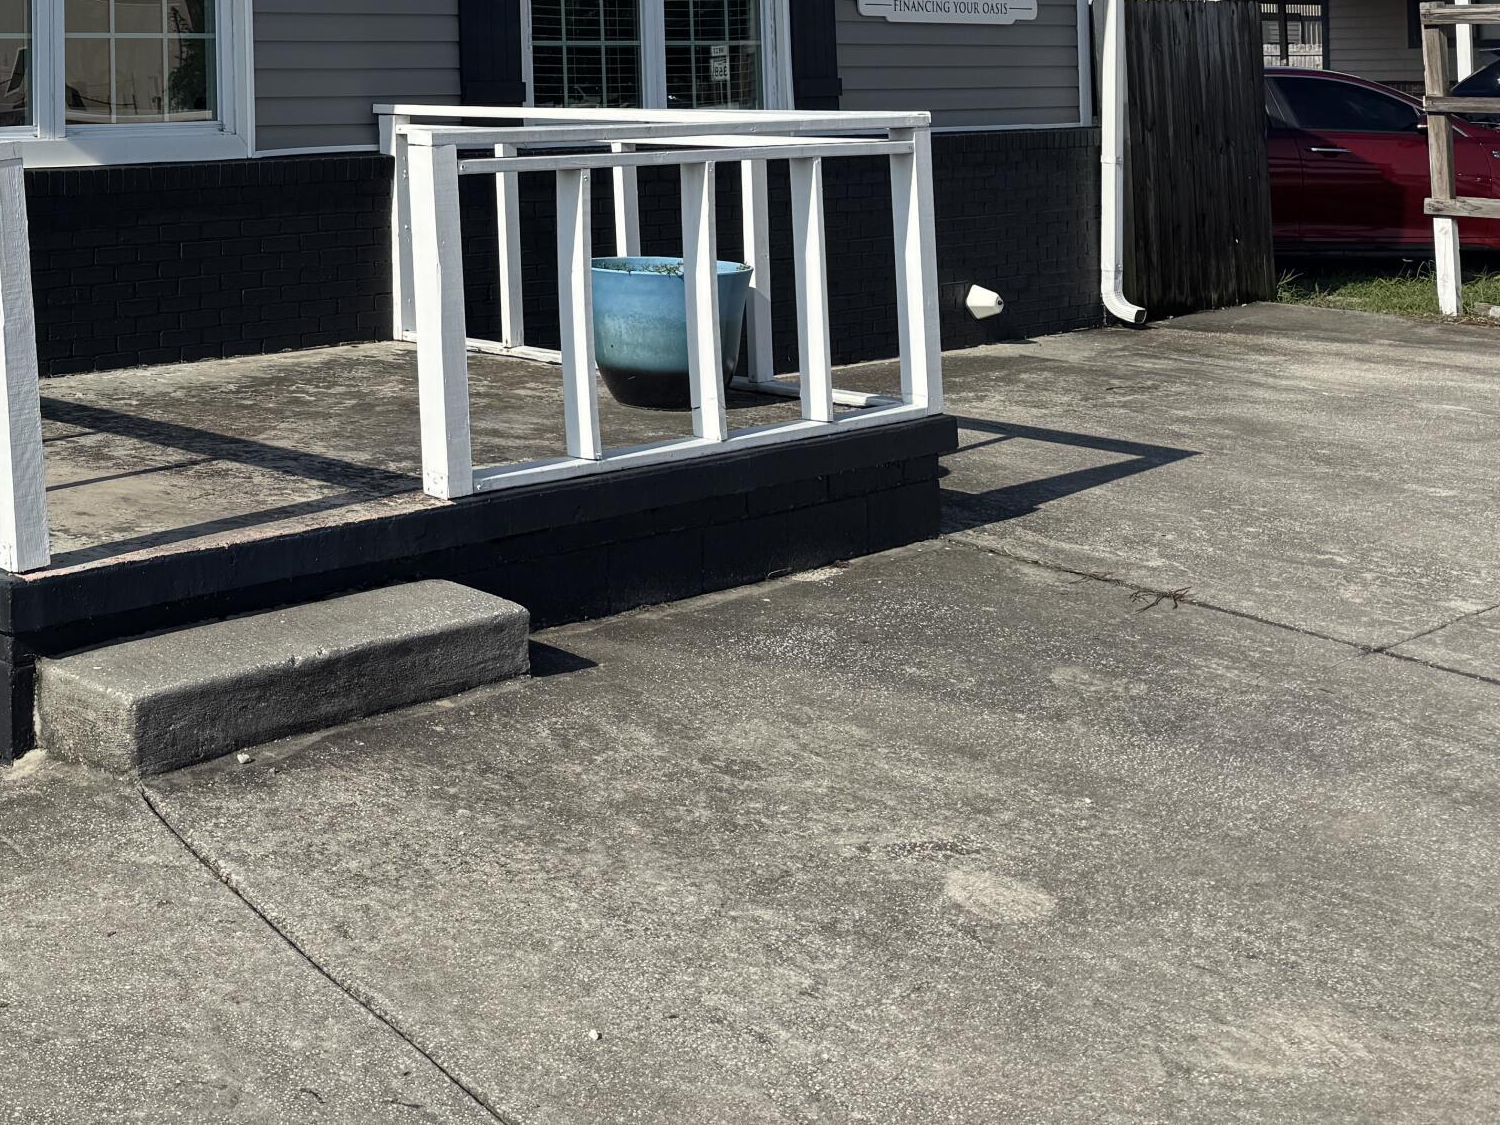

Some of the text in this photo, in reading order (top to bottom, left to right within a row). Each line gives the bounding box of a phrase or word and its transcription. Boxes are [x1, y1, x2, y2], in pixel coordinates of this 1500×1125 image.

[893, 0, 1008, 15] FINANCING YOUR OASIS
